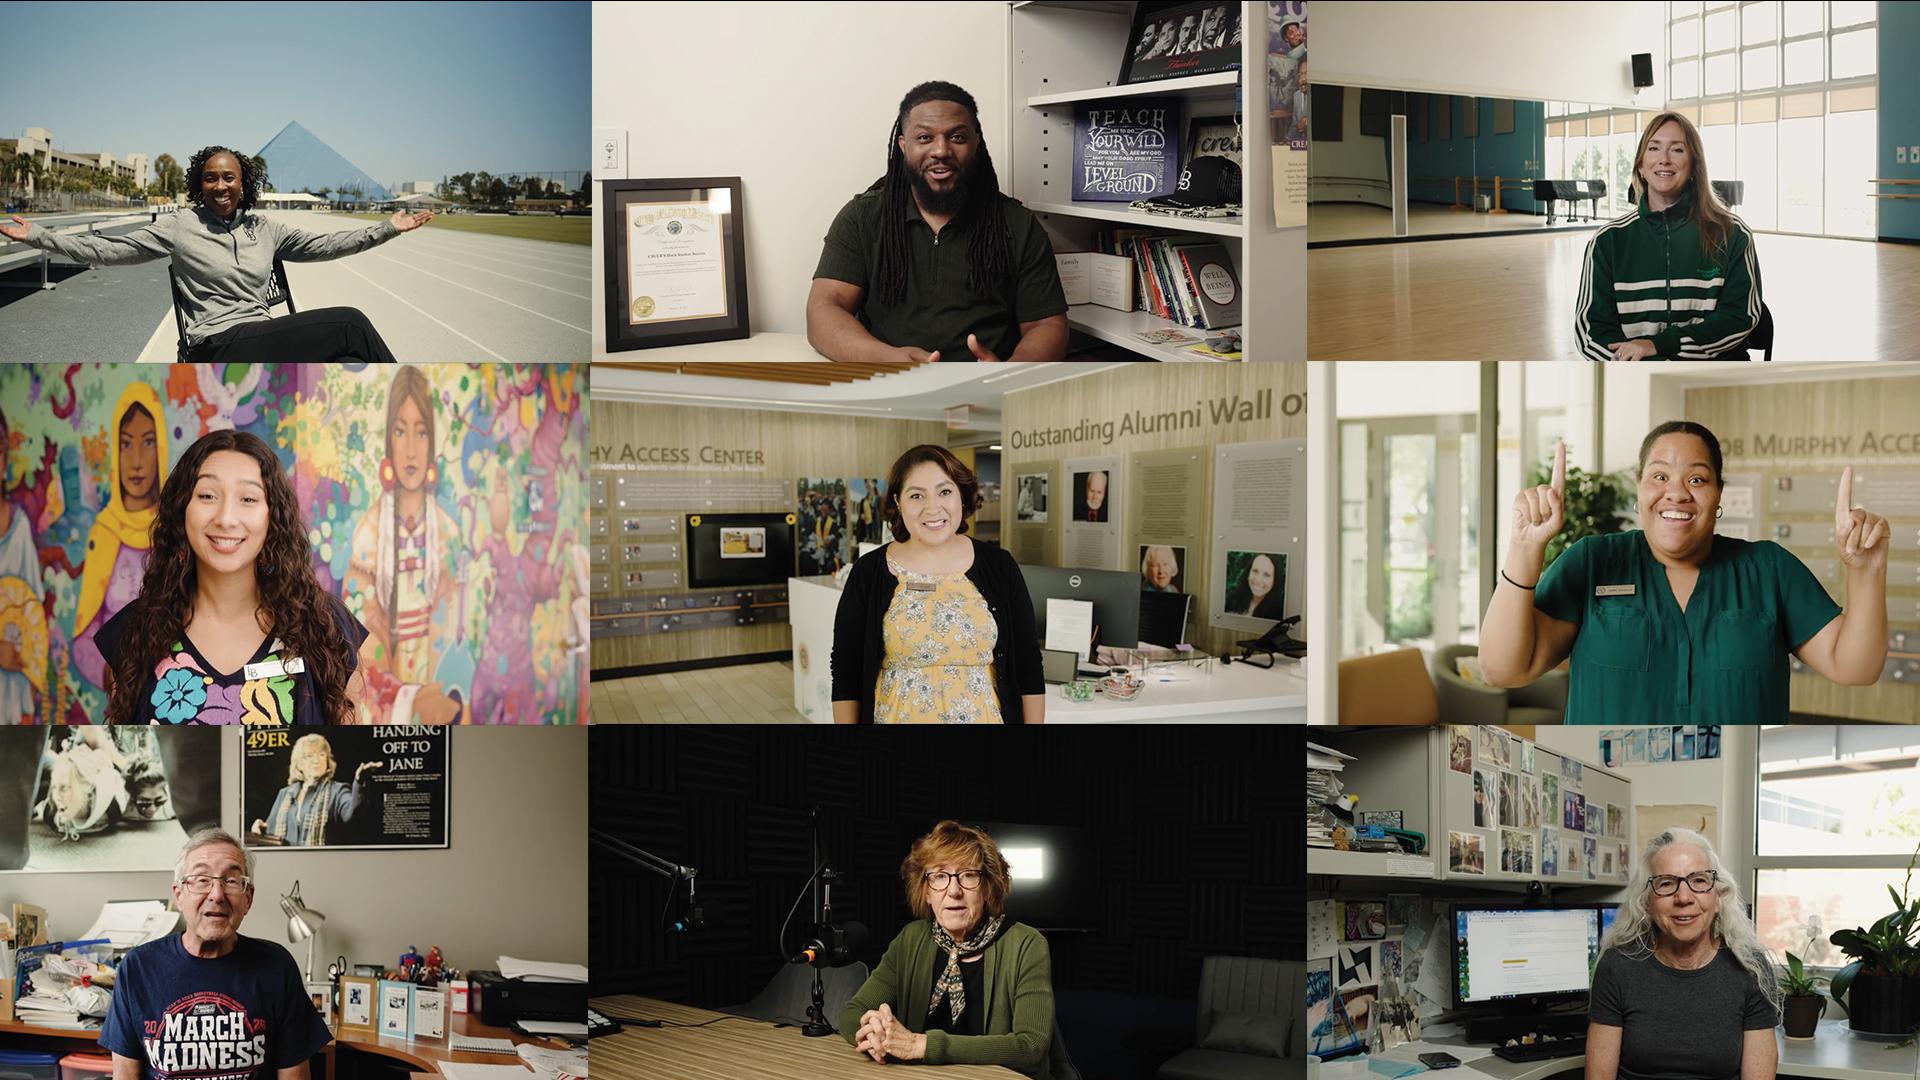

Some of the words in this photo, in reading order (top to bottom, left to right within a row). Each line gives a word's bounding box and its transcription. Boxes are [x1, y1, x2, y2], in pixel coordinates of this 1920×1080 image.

[1088, 108, 1168, 132] TEACH
[1084, 127, 1128, 151] YOUR
[1124, 128, 1165, 150] WILL
[1291, 140, 1307, 148] CRE
[1083, 166, 1125, 192] LEVEL
[1096, 172, 1157, 194] GROUND
[1203, 271, 1226, 280] WELL
[1206, 282, 1231, 290] BEING
[1011, 419, 1114, 450] Outstanding
[1119, 400, 1202, 436] Alumni
[1209, 388, 1272, 425] Wall
[620, 443, 690, 463] ACCESS
[699, 446, 765, 464] CENTER
[1754, 434, 1852, 456] MURPHY
[1859, 432, 1920, 454] ACCE
[246, 731, 290, 748] 49ER
[373, 725, 441, 738] HANDING
[382, 742, 409, 754] OFF
[410, 740, 431, 753] TO
[388, 758, 424, 773] JANE
[144, 1020, 157, 1034] 20
[164, 1012, 245, 1042] MARCH
[144, 1034, 266, 1072] MADNESS
